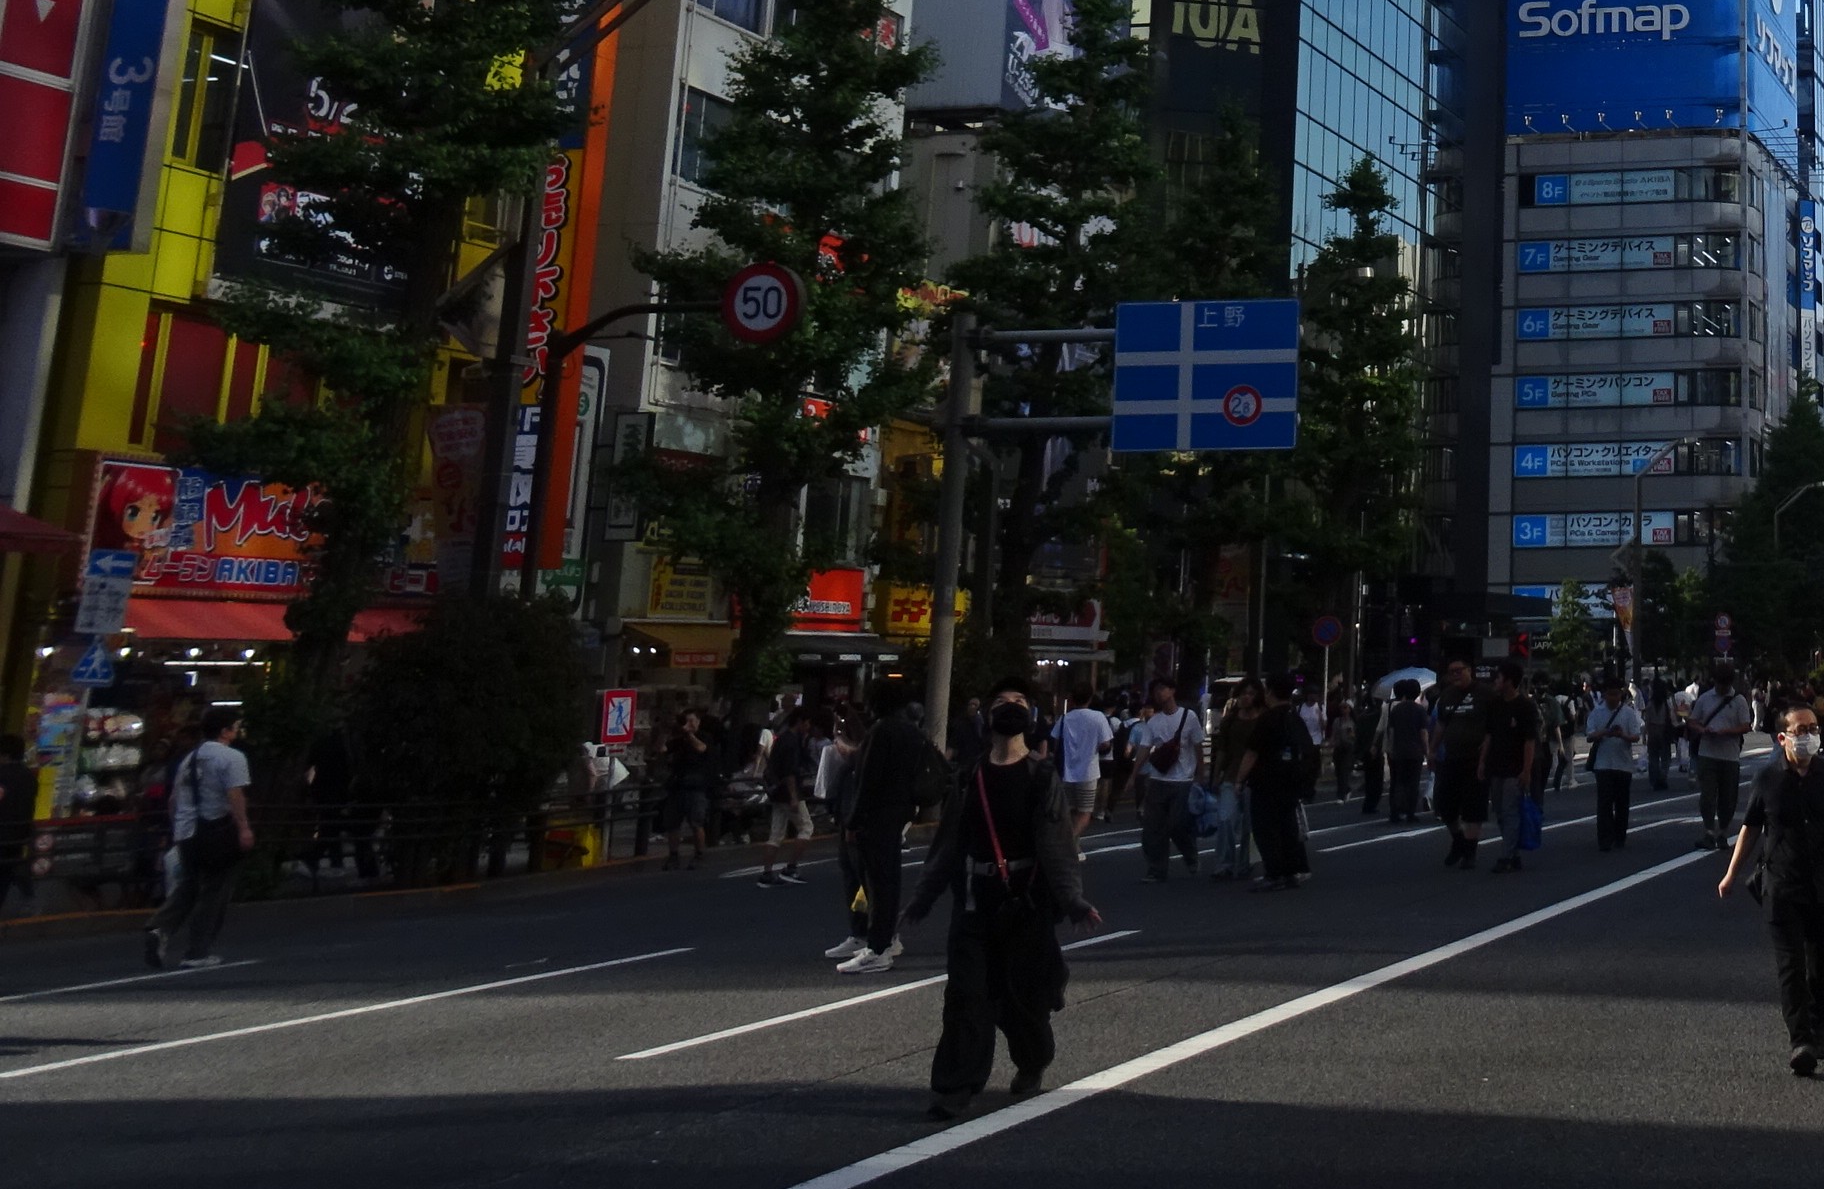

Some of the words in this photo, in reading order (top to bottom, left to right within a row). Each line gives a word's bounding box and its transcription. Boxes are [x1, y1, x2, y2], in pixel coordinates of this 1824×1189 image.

[1518, 0, 1690, 41] Sofmap
[1756, 12, 1798, 96] ソフマップ
[1542, 181, 1563, 199] 8F
[1553, 240, 1655, 253] ゲーミングデバイス
[1524, 248, 1547, 265] 7F
[1801, 235, 1814, 292] ソフマップ
[742, 286, 784, 319] 50
[1197, 305, 1246, 328] 上野
[1552, 308, 1656, 321] ゲーミングデバイス
[1523, 315, 1545, 333] 6F
[1521, 383, 1544, 401] 5F
[1552, 376, 1654, 390] ゲーミングパソコン
[1551, 445, 1662, 458] パソコン・クリエイター
[1521, 452, 1543, 470] 4F
[1577, 459, 1631, 467] Workstations
[1570, 515, 1653, 528] パソコン・カラ
[1519, 522, 1543, 540] 3F
[143, 551, 216, 582] ムーラン
[215, 556, 300, 586] AKIBA
